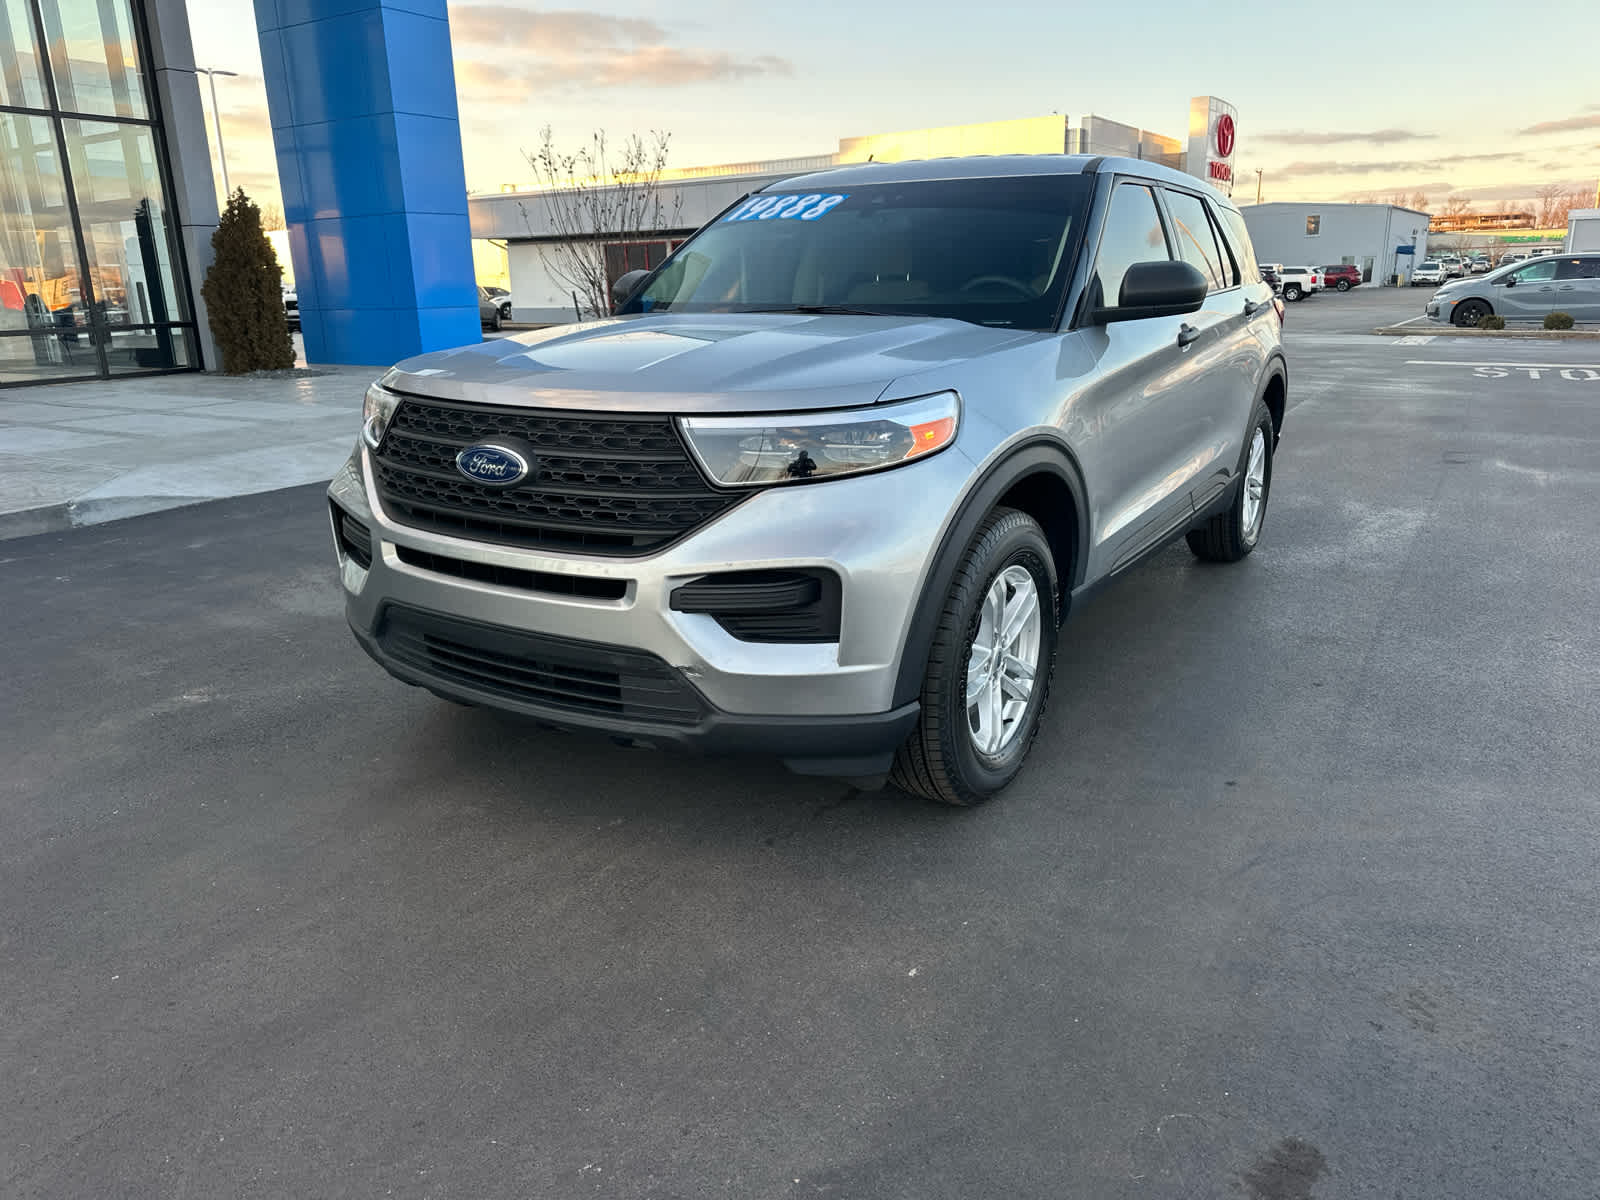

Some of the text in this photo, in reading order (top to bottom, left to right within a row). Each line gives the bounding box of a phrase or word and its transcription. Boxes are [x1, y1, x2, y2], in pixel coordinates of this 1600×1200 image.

[1209, 161, 1231, 181] TOYO
[727, 194, 844, 222] 19888
[469, 452, 509, 477] Ford
